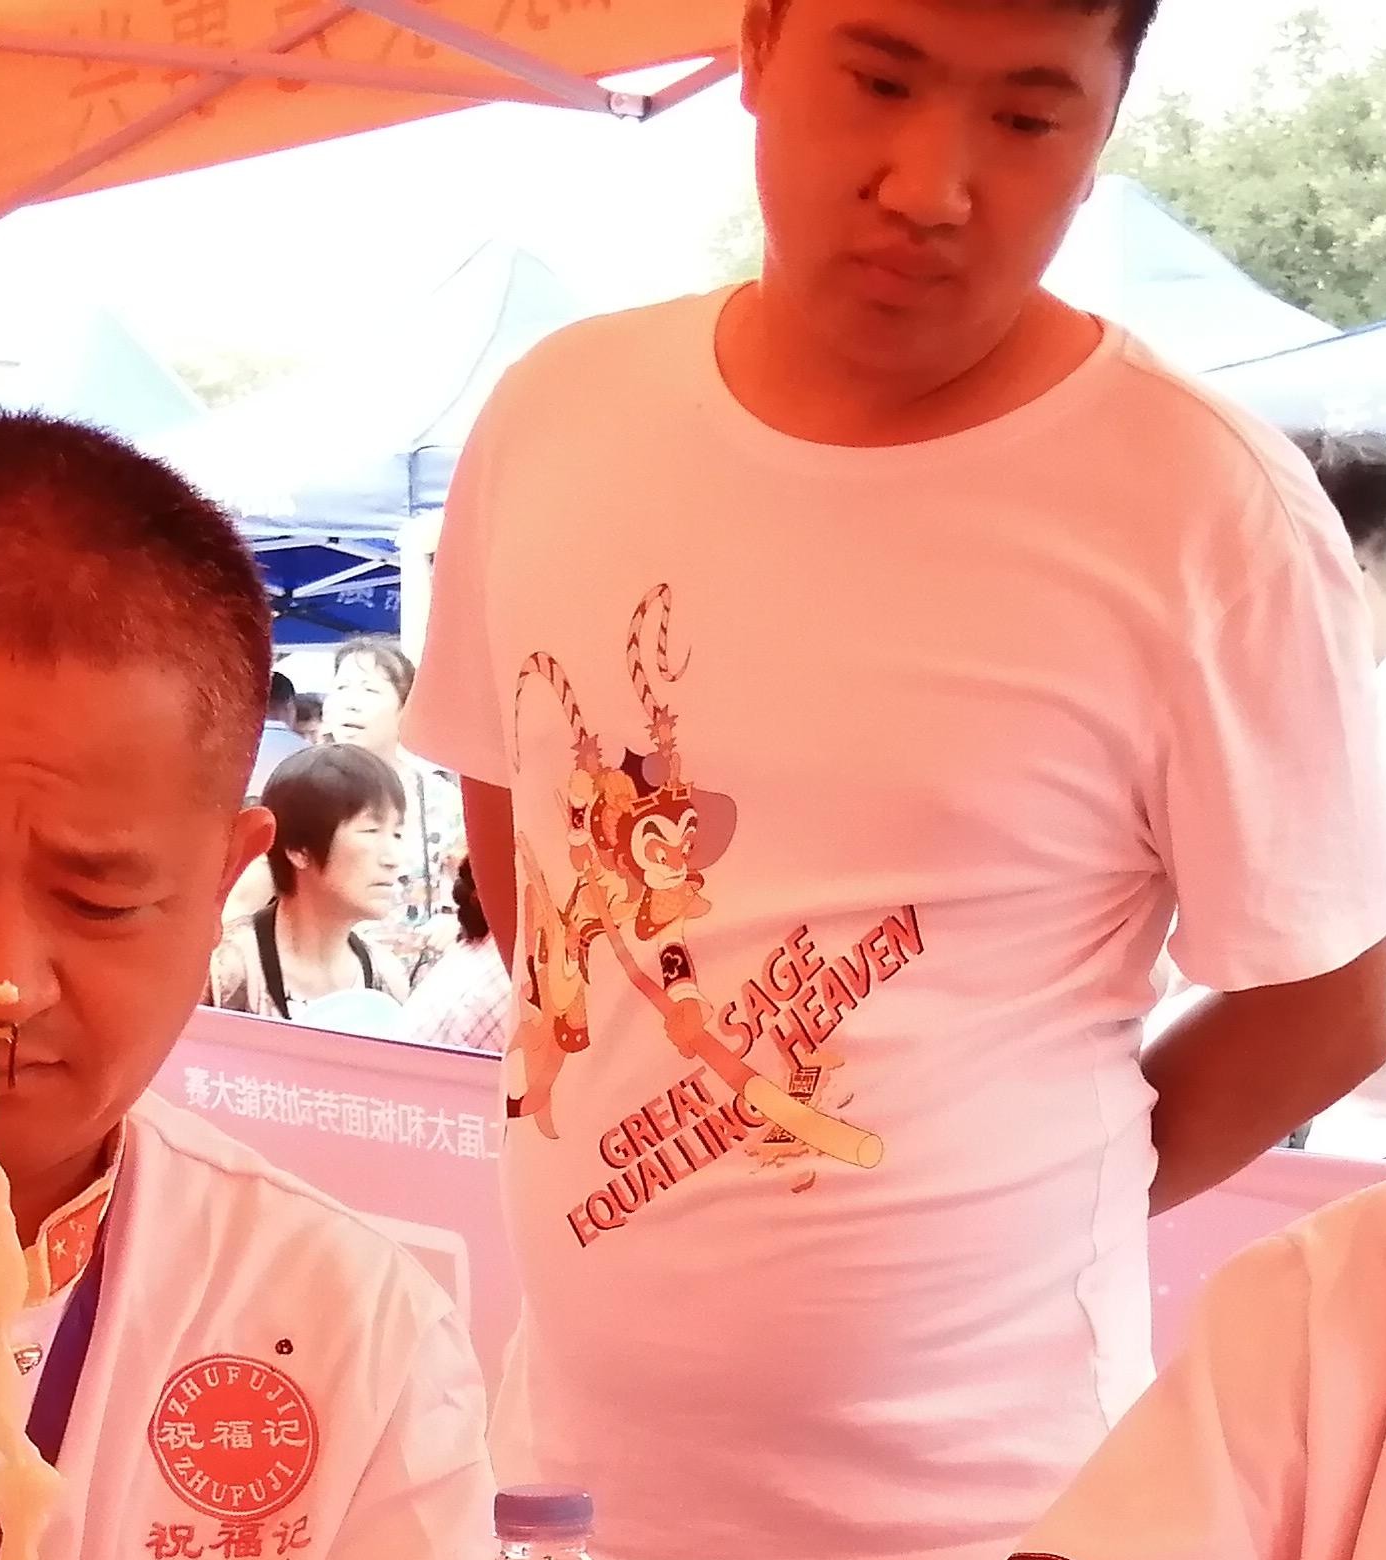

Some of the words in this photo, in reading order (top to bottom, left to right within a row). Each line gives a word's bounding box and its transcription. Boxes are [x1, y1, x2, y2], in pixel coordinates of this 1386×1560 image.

[768, 904, 925, 1070] HEAVEN
[599, 1066, 717, 1170] GREAT
[716, 924, 826, 1060] SAGE
[167, 1365, 299, 1417] ZHUFUJI
[158, 1419, 308, 1451] 祝福记
[174, 1455, 294, 1507] ZHUFUJI
[145, 1514, 312, 1560] 祝福记
